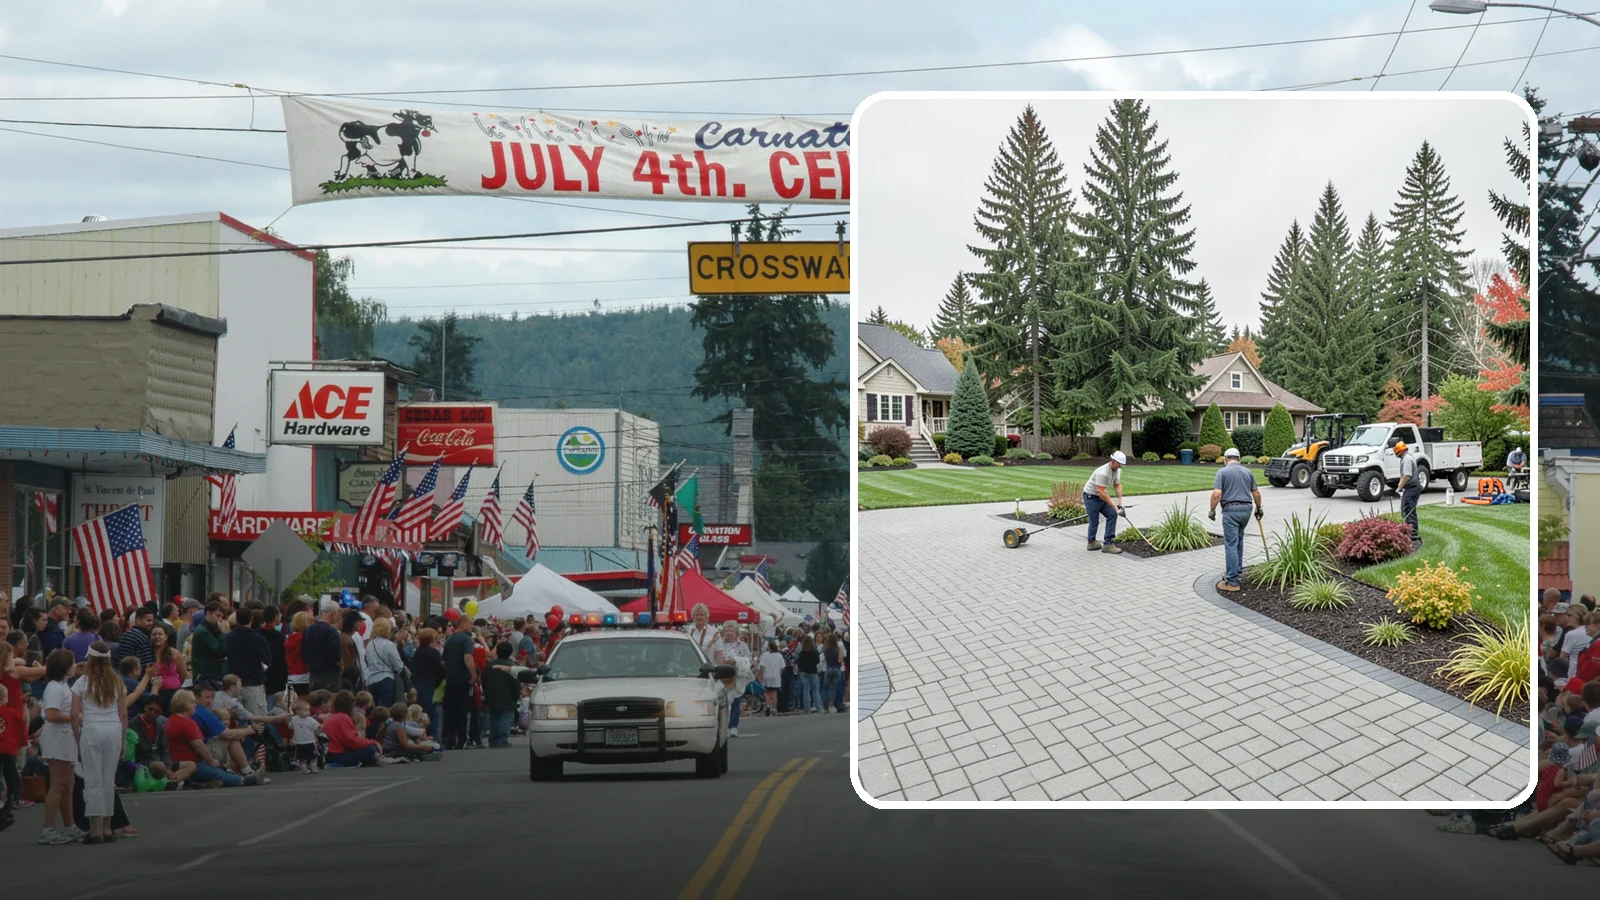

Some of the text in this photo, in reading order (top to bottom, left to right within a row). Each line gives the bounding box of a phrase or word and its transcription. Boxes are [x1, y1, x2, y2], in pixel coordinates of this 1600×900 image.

[481, 140, 605, 192] JULY
[632, 150, 746, 198] 4th.
[696, 254, 850, 280] CROSSWA
[282, 380, 374, 420] ACE
[405, 409, 453, 421] CEDAR
[283, 421, 371, 436] Hardware
[416, 427, 477, 447] Coca-Cola
[353, 466, 386, 480] Simpl
[95, 485, 124, 495] Vincent
[126, 486, 136, 495] de
[137, 486, 155, 495] Paul
[688, 526, 741, 535] CRNATION
[699, 535, 730, 543] GLASS
